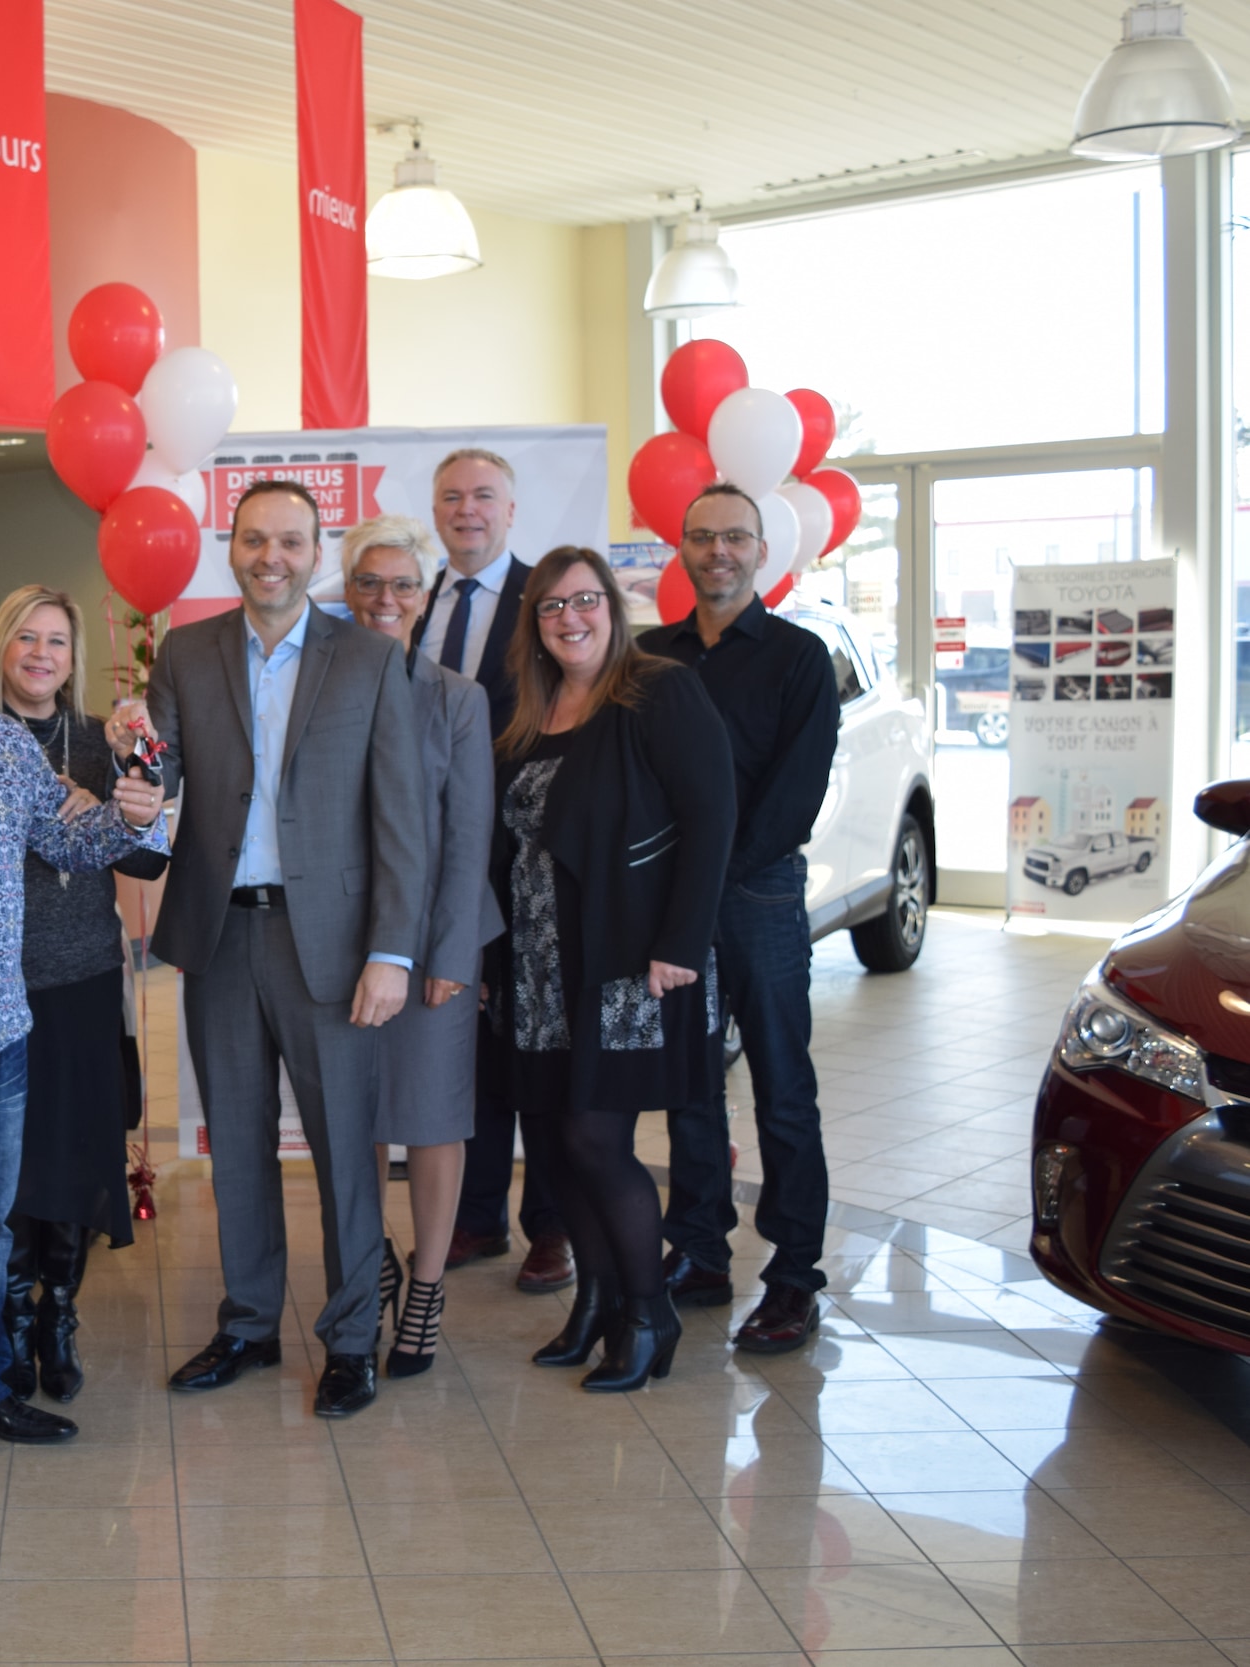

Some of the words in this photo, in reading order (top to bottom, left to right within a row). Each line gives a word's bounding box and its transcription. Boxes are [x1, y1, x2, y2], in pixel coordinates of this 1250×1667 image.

[308, 184, 357, 232] mieux
[227, 470, 267, 489] DES
[273, 468, 344, 487] PNEUS
[1057, 584, 1136, 602] TOYOTA
